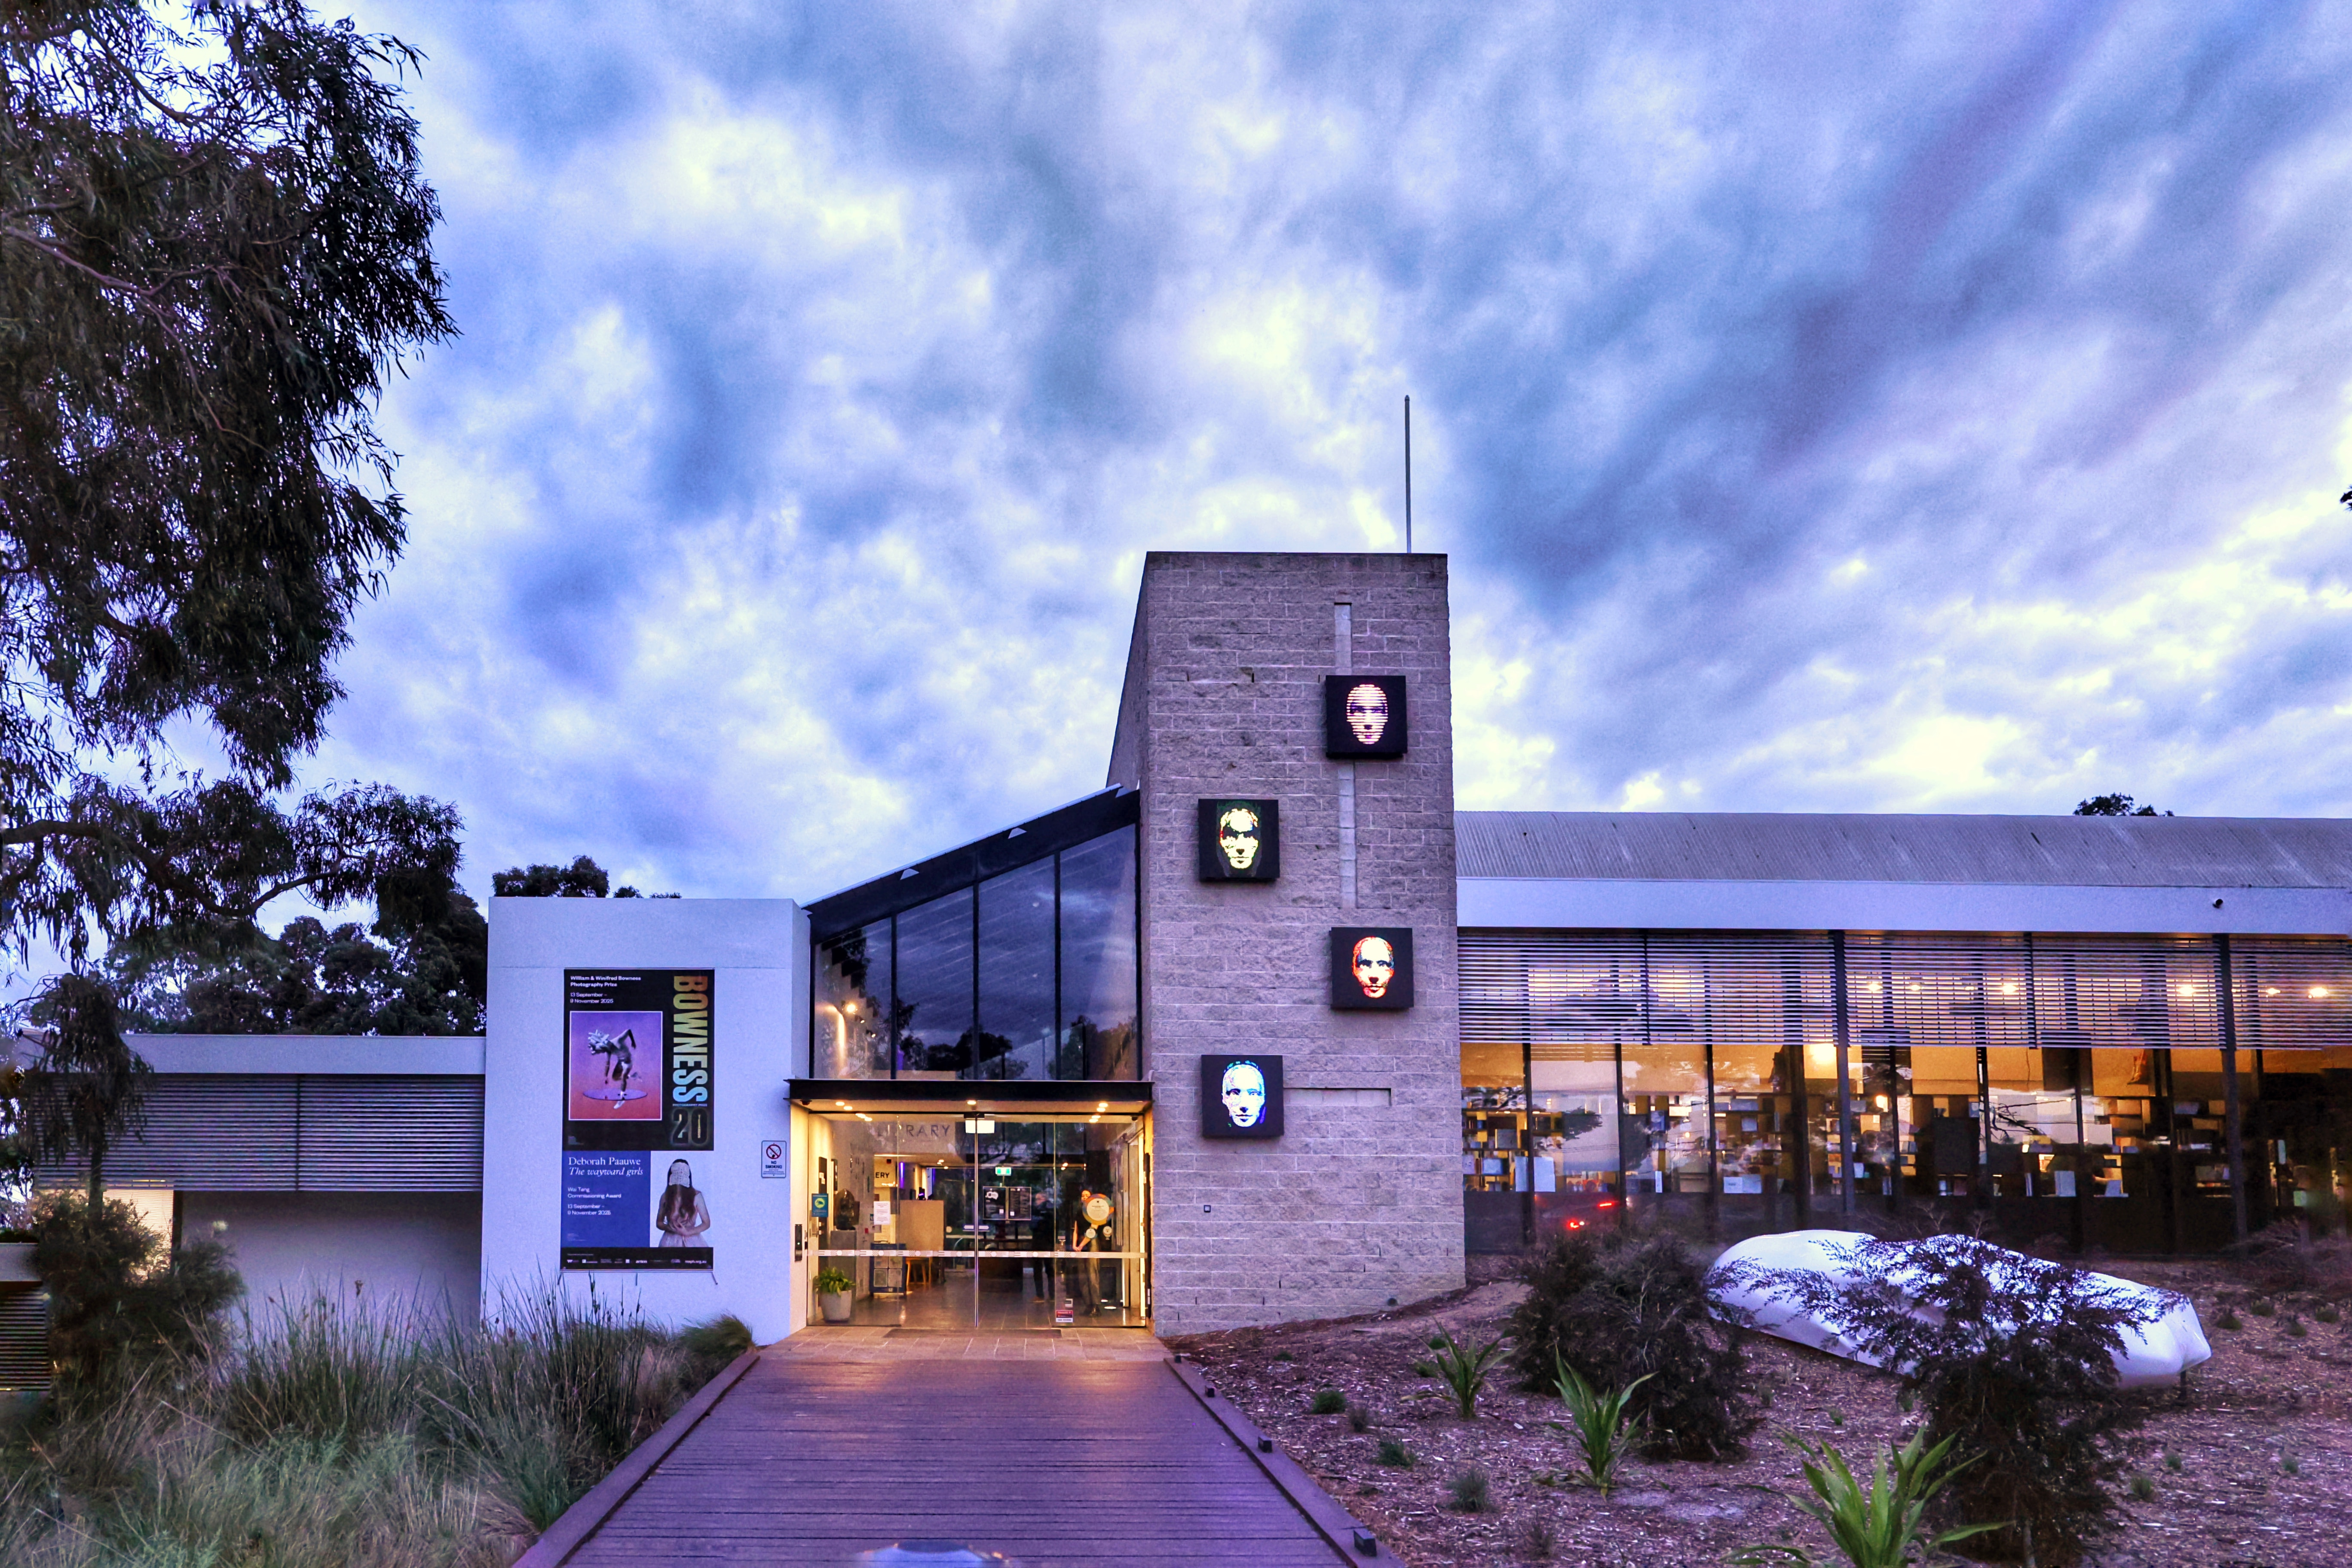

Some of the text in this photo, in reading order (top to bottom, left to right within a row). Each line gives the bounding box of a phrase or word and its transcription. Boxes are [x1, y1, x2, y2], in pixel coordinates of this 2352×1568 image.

[673, 976, 708, 1102] BOWNESS
[673, 1109, 707, 1144] 20
[878, 1124, 950, 1137] LIRARY
[568, 1157, 641, 1165] Deborah Paauwe
[587, 1167, 625, 1177] wayward
[626, 1167, 643, 1176] girls
